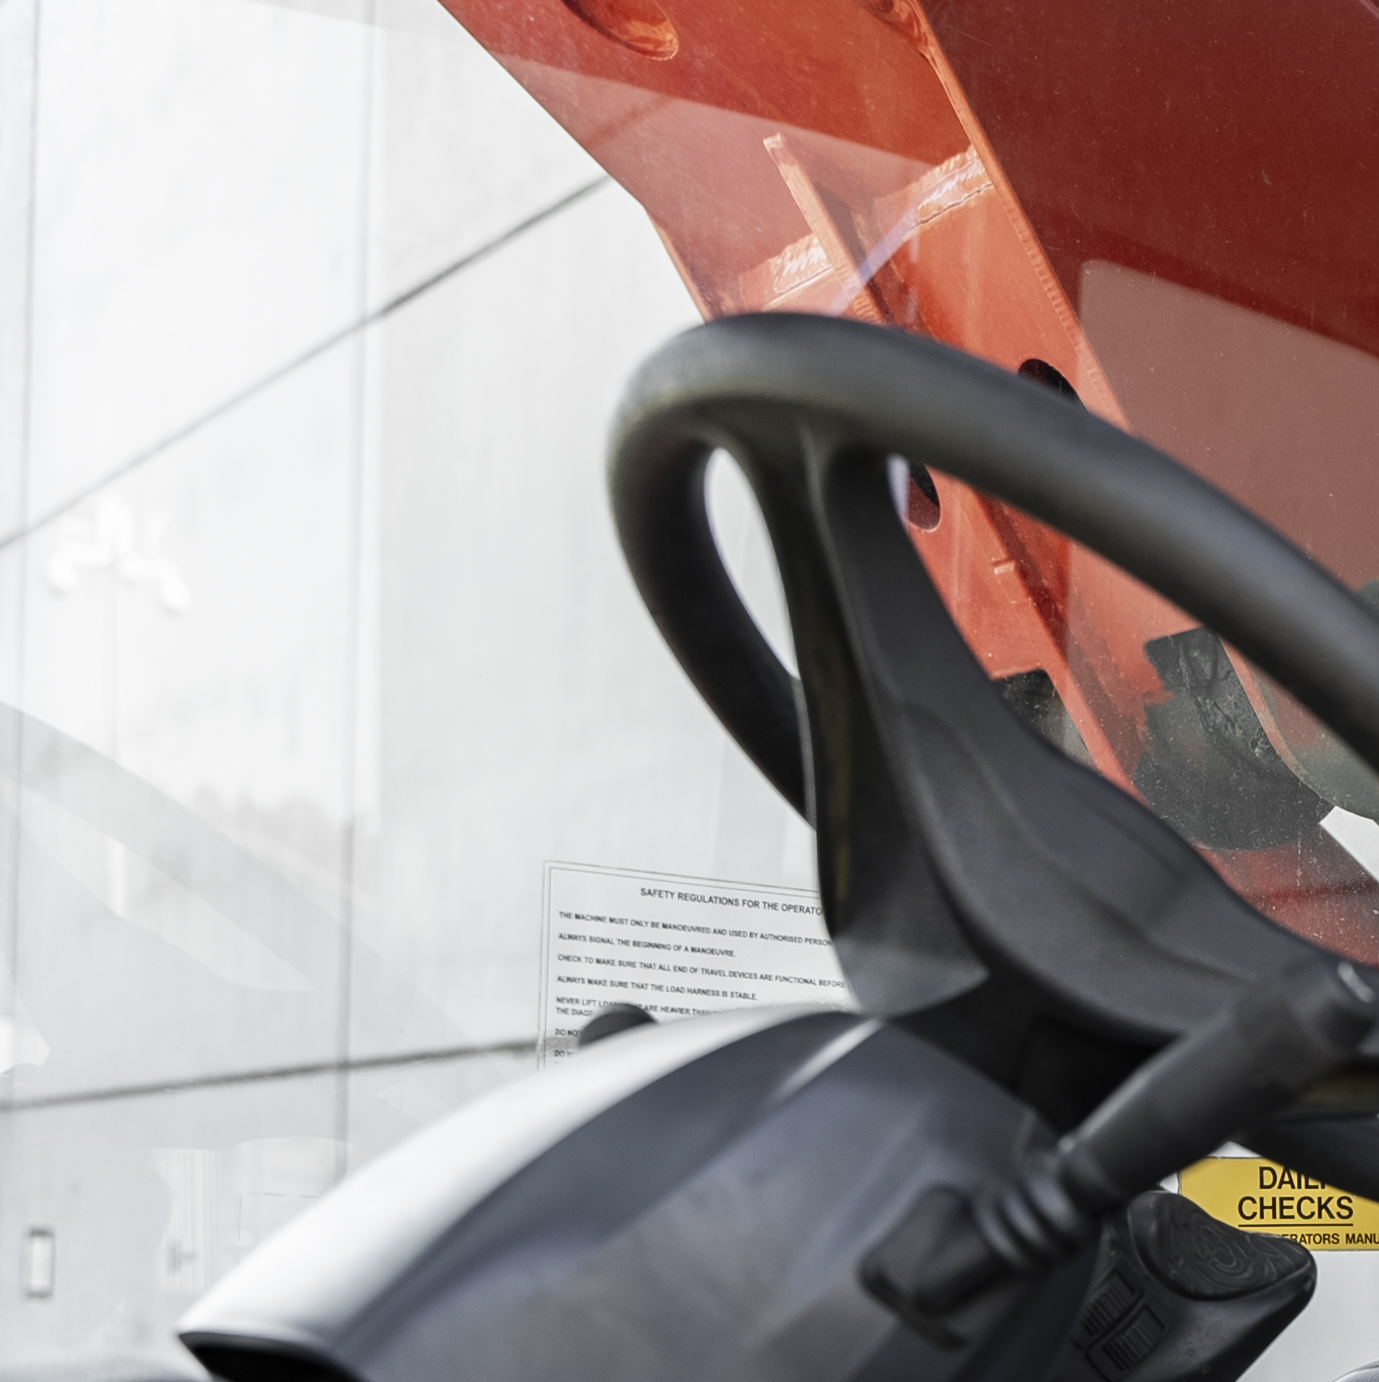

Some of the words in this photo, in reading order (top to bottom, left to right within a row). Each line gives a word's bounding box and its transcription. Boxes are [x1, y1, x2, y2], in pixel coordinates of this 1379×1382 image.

[641, 888, 676, 900] SAFETY
[677, 892, 739, 907] REGULATIONS
[742, 898, 760, 909] FOR
[763, 900, 779, 911] THE
[559, 911, 573, 919] THE
[575, 913, 607, 923] MACHINE
[609, 916, 628, 925] MUST
[630, 919, 649, 927] ONLY
[651, 921, 660, 929] BE
[662, 922, 711, 934] MANOEUVRED
[713, 927, 727, 936] AND
[729, 929, 748, 938] USED
[750, 931, 758, 939] BY
[760, 932, 803, 944] AUTHORISED
[559, 934, 587, 943] ALWAYS
[589, 937, 615, 946] SIGNAL
[632, 941, 671, 951] BEGINNING
[558, 954, 582, 963] CHECK
[596, 958, 616, 966] MAKE
[618, 960, 637, 968] SURE
[640, 962, 656, 970] THAT
[658, 964, 671, 972] ALL
[673, 965, 688, 973] END
[701, 968, 727, 977] TRAVEL
[729, 971, 757, 980] DEVICES
[775, 975, 816, 986] FUNCTIONAL
[557, 976, 585, 985] ALWAYS
[588, 979, 608, 987] MAKE
[610, 980, 629, 989] SURE
[631, 982, 649, 991] THAT
[651, 984, 664, 992] THE
[666, 985, 685, 994] LOAD
[687, 987, 720, 997] HARNESS
[722, 990, 728, 998] IS
[556, 997, 580, 1006] NEVER
[582, 999, 597, 1007] LIFT
[660, 1006, 690, 1015] HEAVIER
[556, 1007, 570, 1015] THE
[1259, 1166, 1326, 1190] DAIL
[1238, 1196, 1354, 1220] CHECKS
